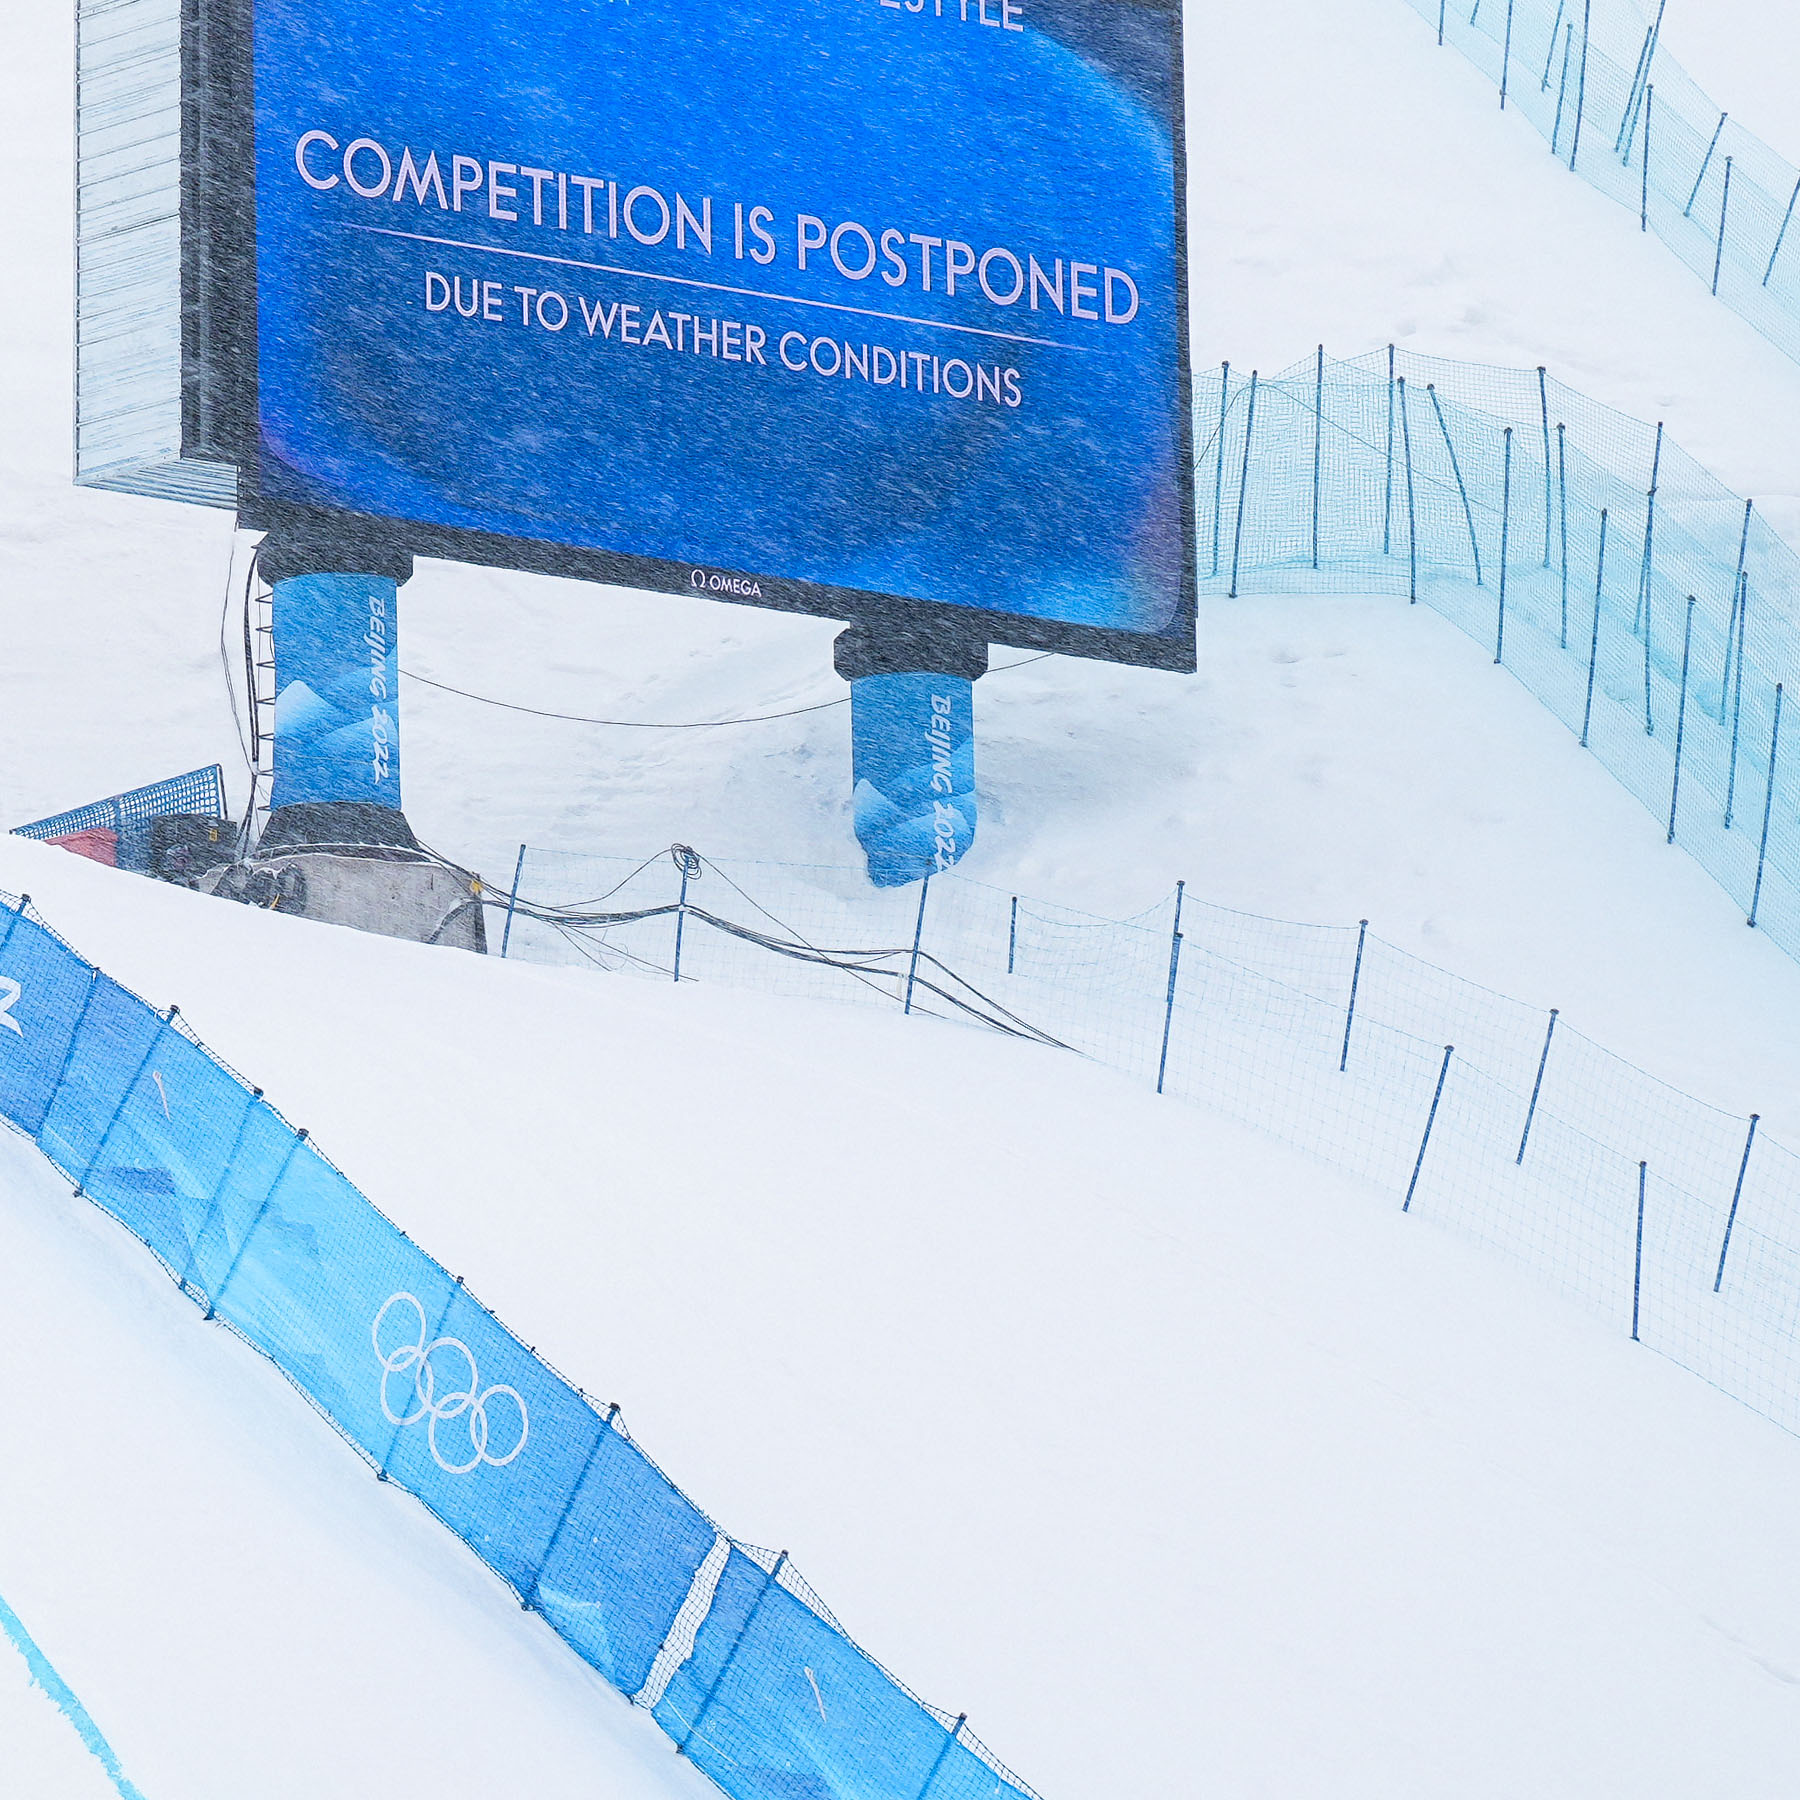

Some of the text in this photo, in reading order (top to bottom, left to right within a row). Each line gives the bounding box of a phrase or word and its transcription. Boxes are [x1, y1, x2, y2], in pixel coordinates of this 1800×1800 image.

[295, 130, 1139, 325] COMPETITION IS POSTPONED
[425, 272, 1022, 408] DUE TO WEATHER CONDITIONS
[709, 575, 762, 598] OMEGA
[363, 595, 390, 785] BEIJING 2022
[924, 693, 953, 794] BEIJING
